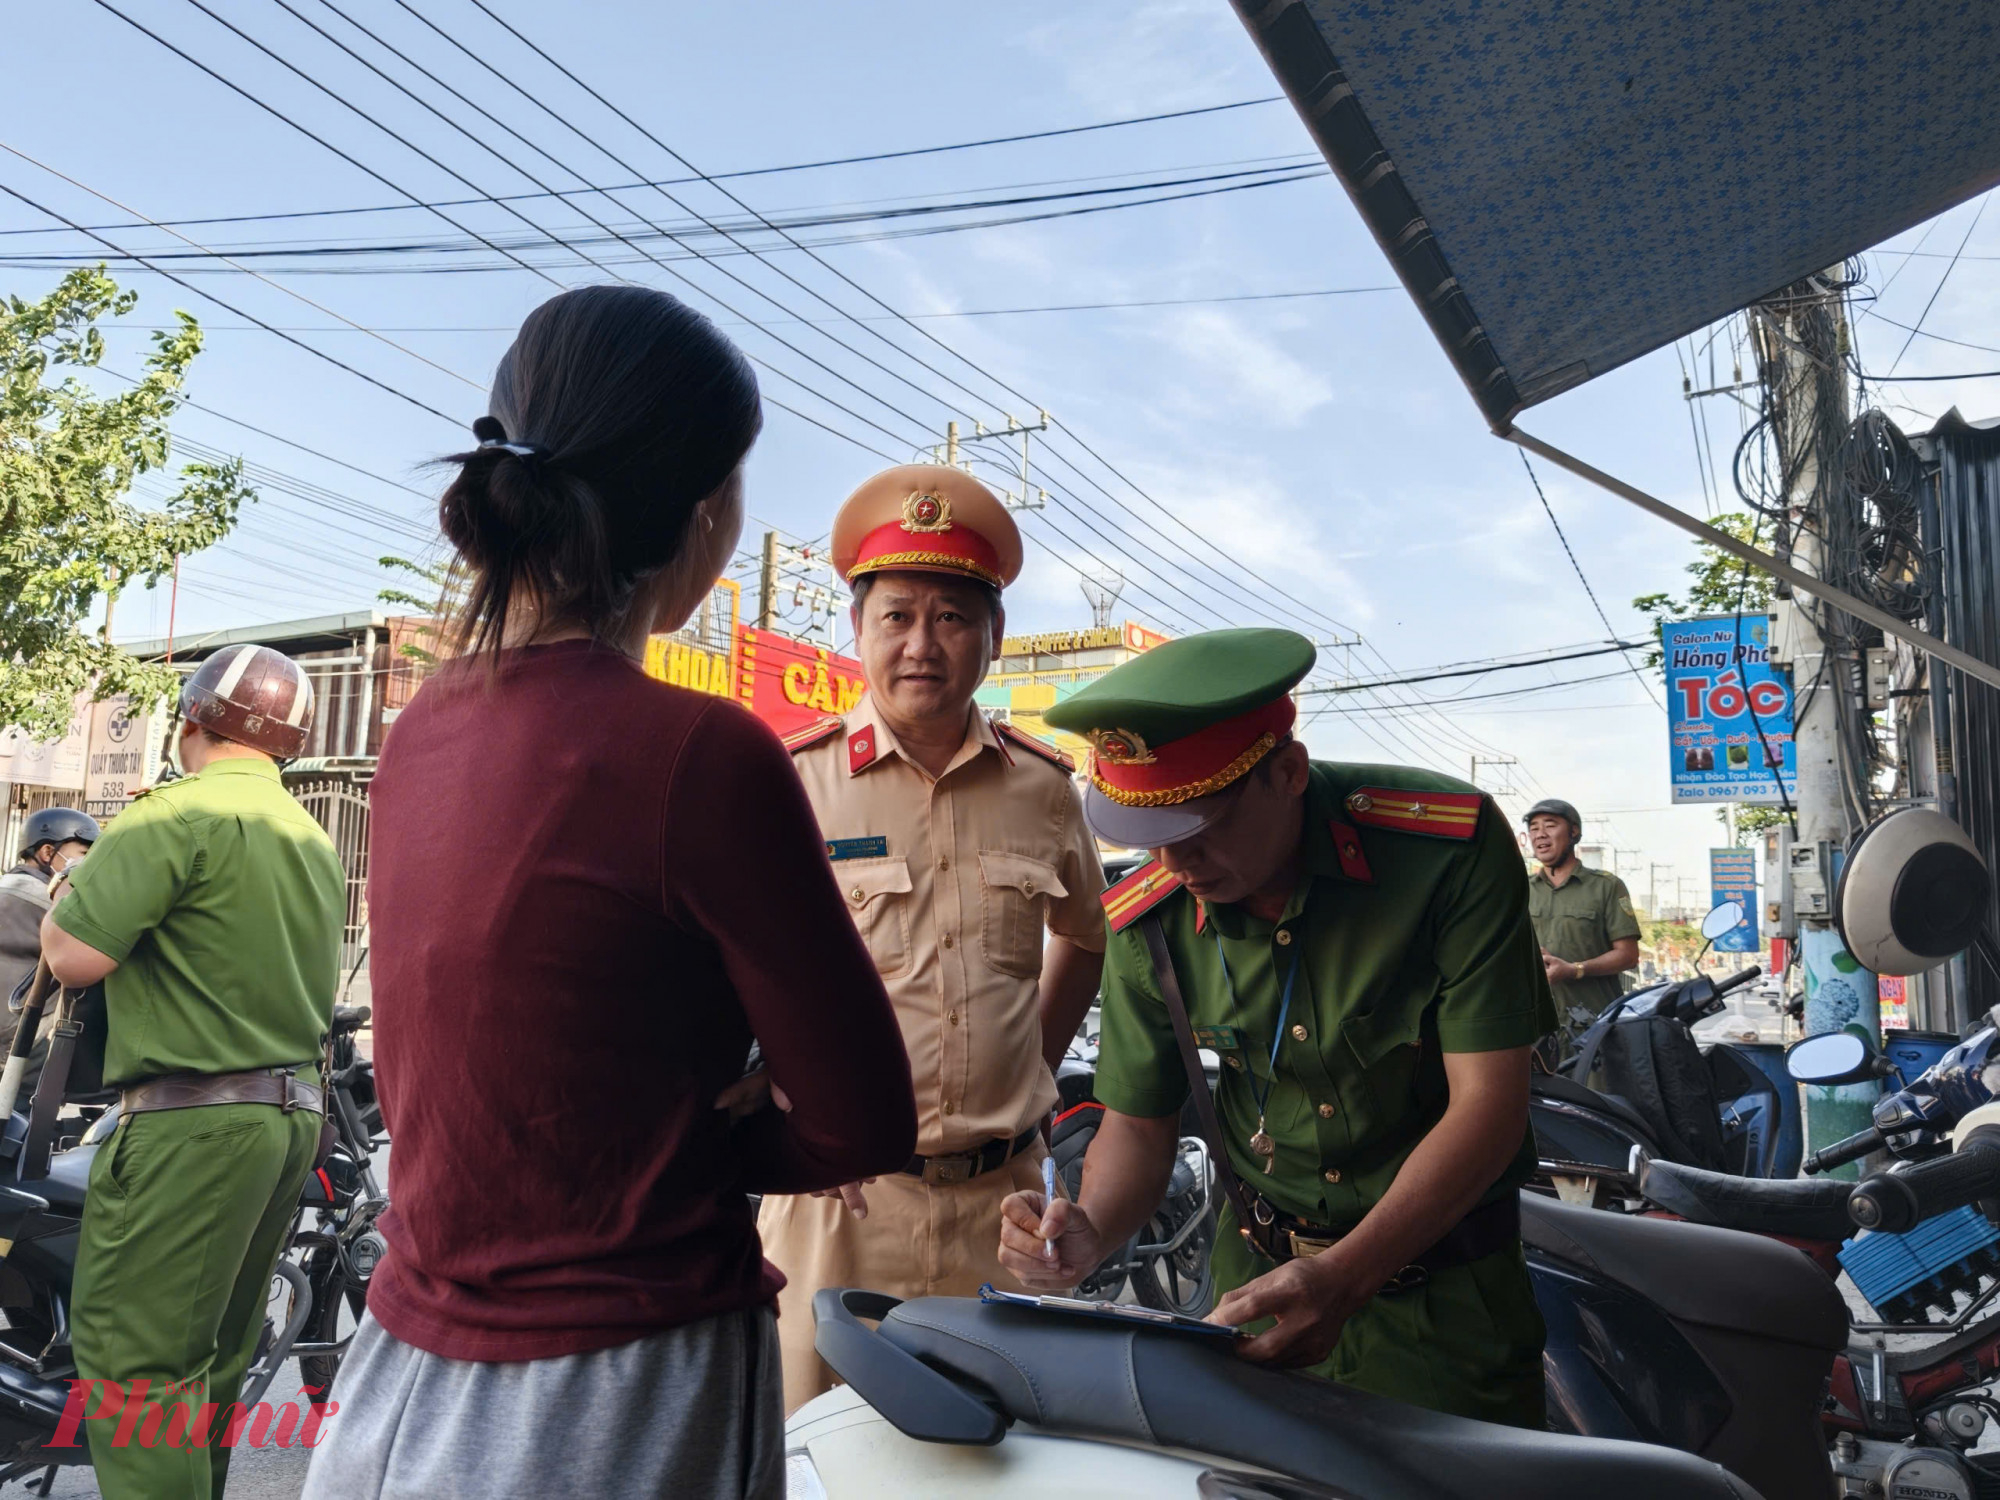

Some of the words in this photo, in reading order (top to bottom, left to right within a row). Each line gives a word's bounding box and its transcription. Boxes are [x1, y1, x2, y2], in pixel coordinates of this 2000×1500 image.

[1033, 632, 1070, 653] COFFEE
[1083, 625, 1122, 648] CINEMA
[1673, 633, 1710, 645] Salon
[1673, 646, 1727, 669] Hồng
[102, 782, 124, 798] 533
[1677, 787, 1704, 797] Zalo
[1708, 786, 1739, 796] 0967
[1743, 785, 1767, 795] 093
[1772, 783, 1795, 794] 79
[87, 802, 103, 816] BAO
[1899, 1487, 1960, 1500] HONDA
